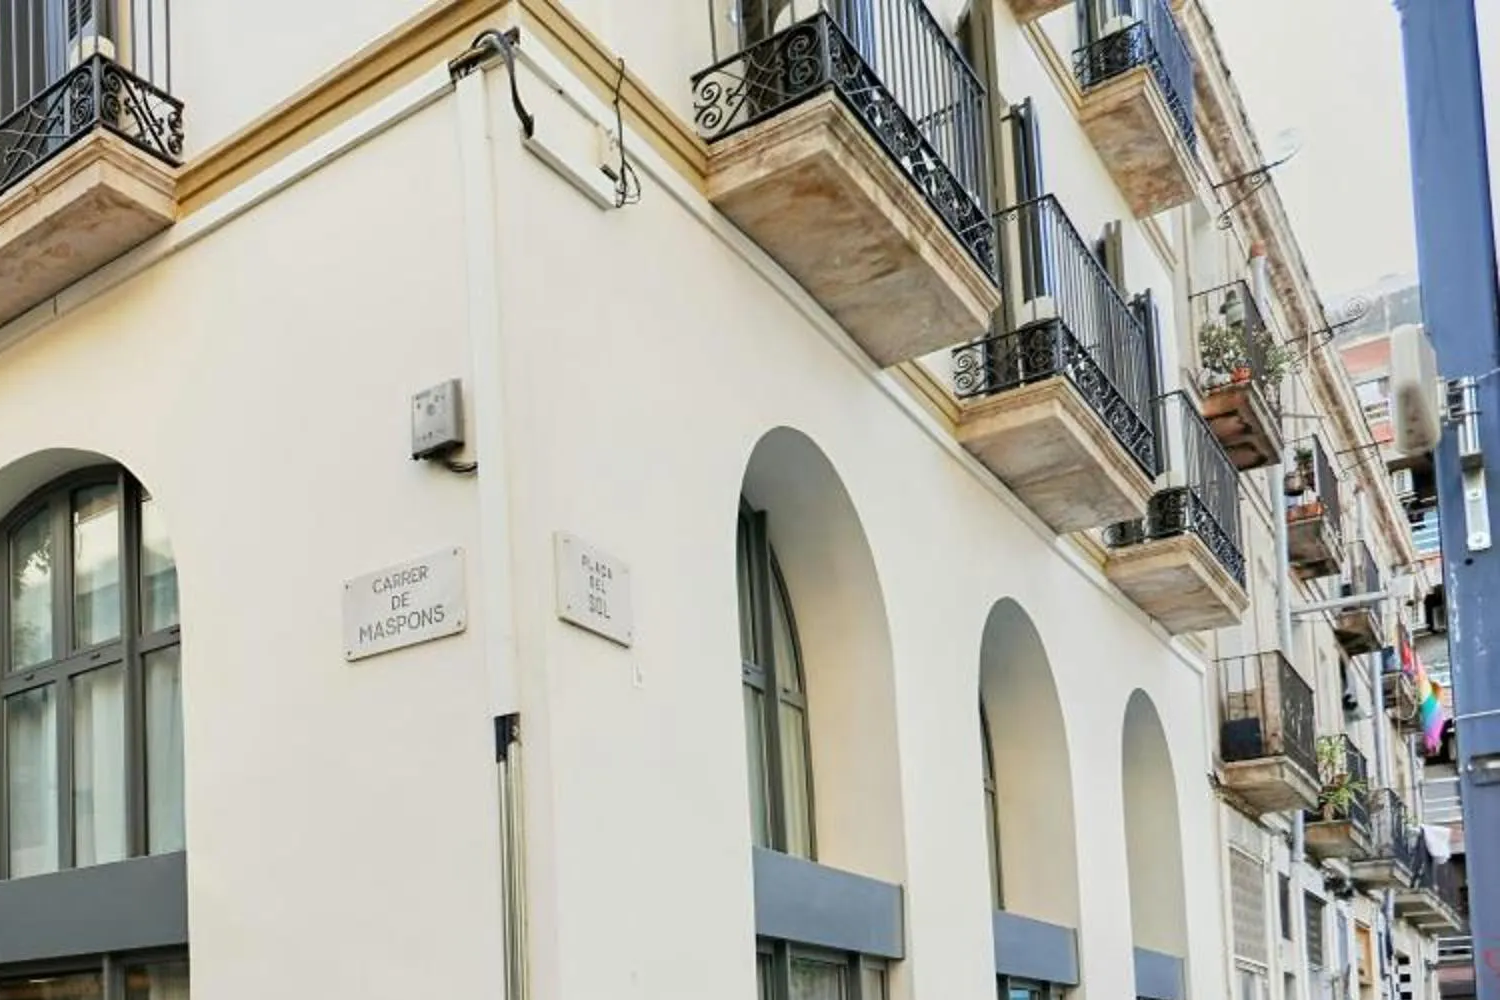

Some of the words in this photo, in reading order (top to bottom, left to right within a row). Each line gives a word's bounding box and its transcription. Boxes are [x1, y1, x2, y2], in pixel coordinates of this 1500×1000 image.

[372, 565, 429, 594] CARRER
[391, 592, 411, 611] DE
[358, 603, 445, 644] MASPONS
